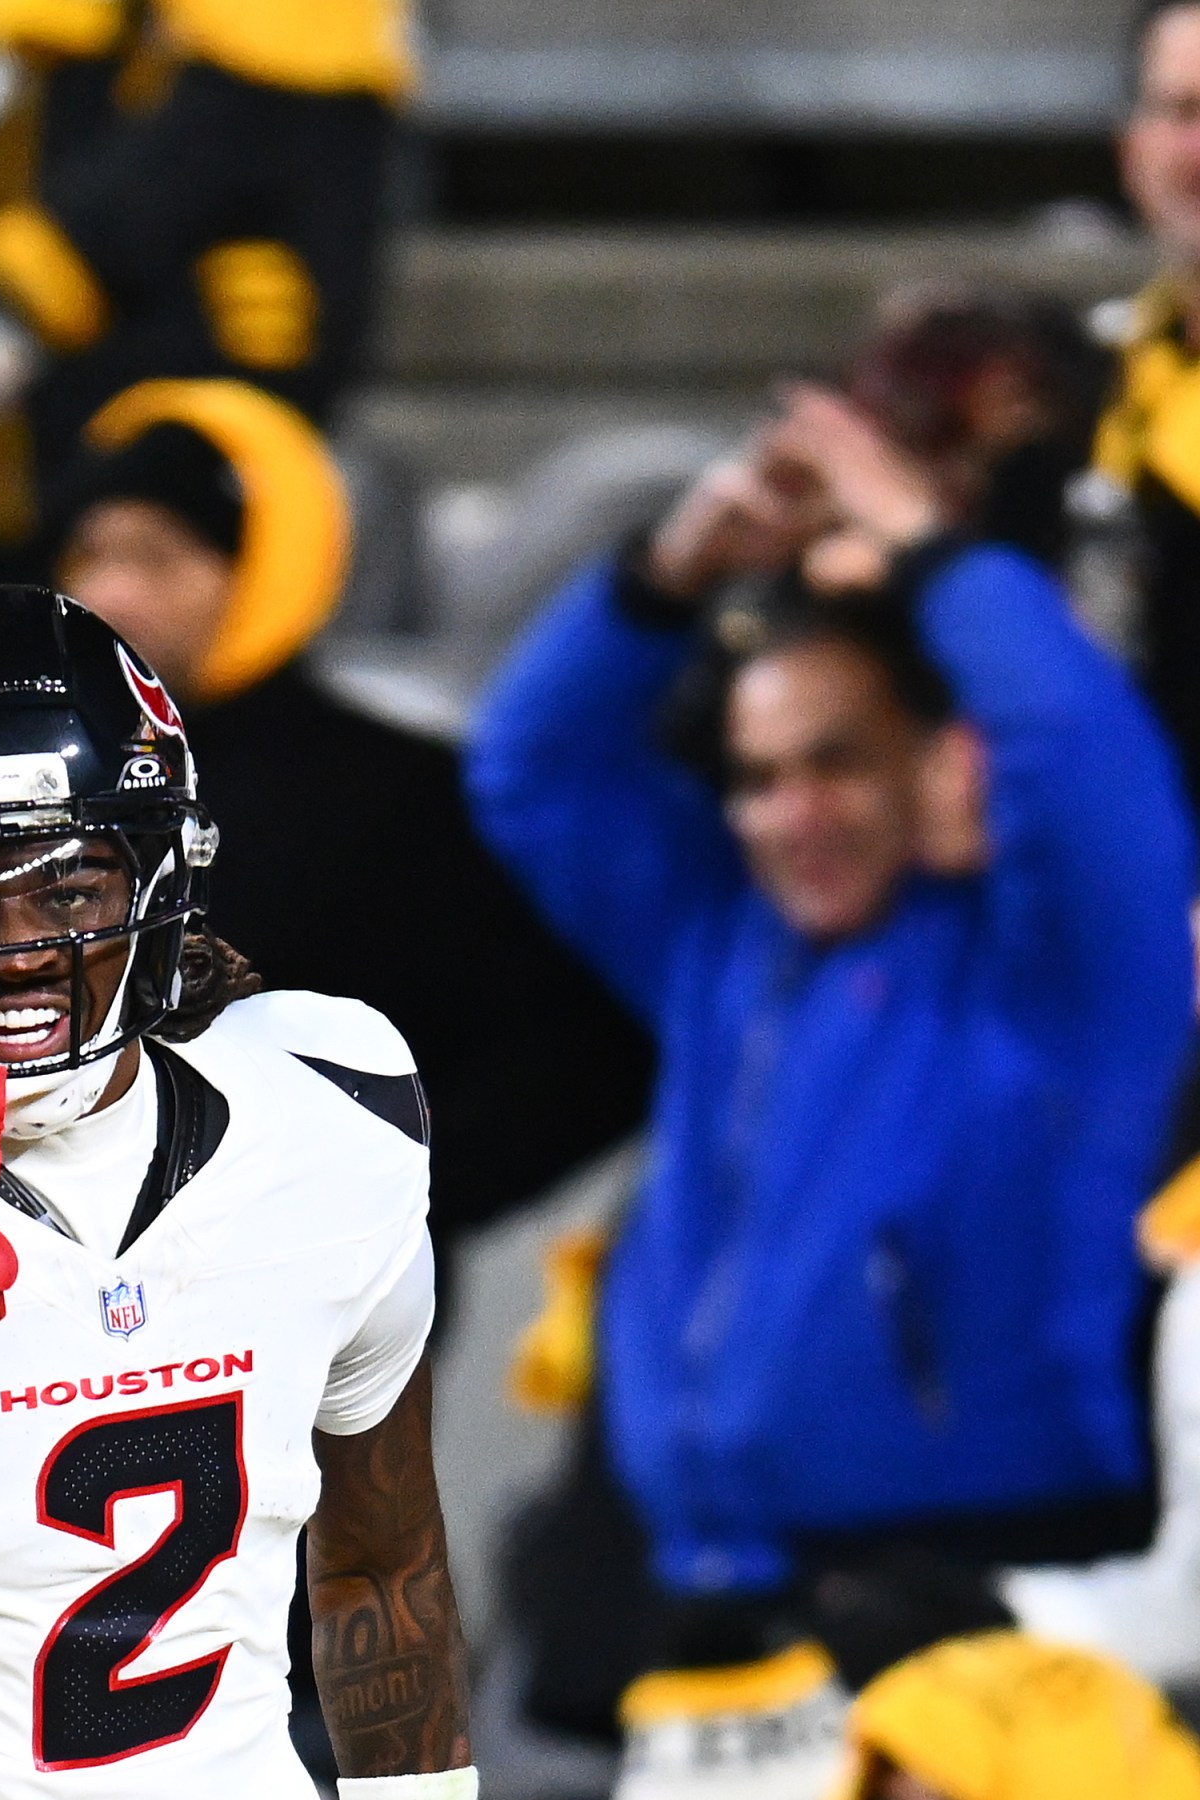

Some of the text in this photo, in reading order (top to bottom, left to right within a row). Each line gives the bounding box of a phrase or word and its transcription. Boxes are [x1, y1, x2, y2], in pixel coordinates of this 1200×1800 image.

[109, 1304, 142, 1330] NFL
[0, 1349, 254, 1413] HOUSTON
[33, 1389, 249, 1773] 2
